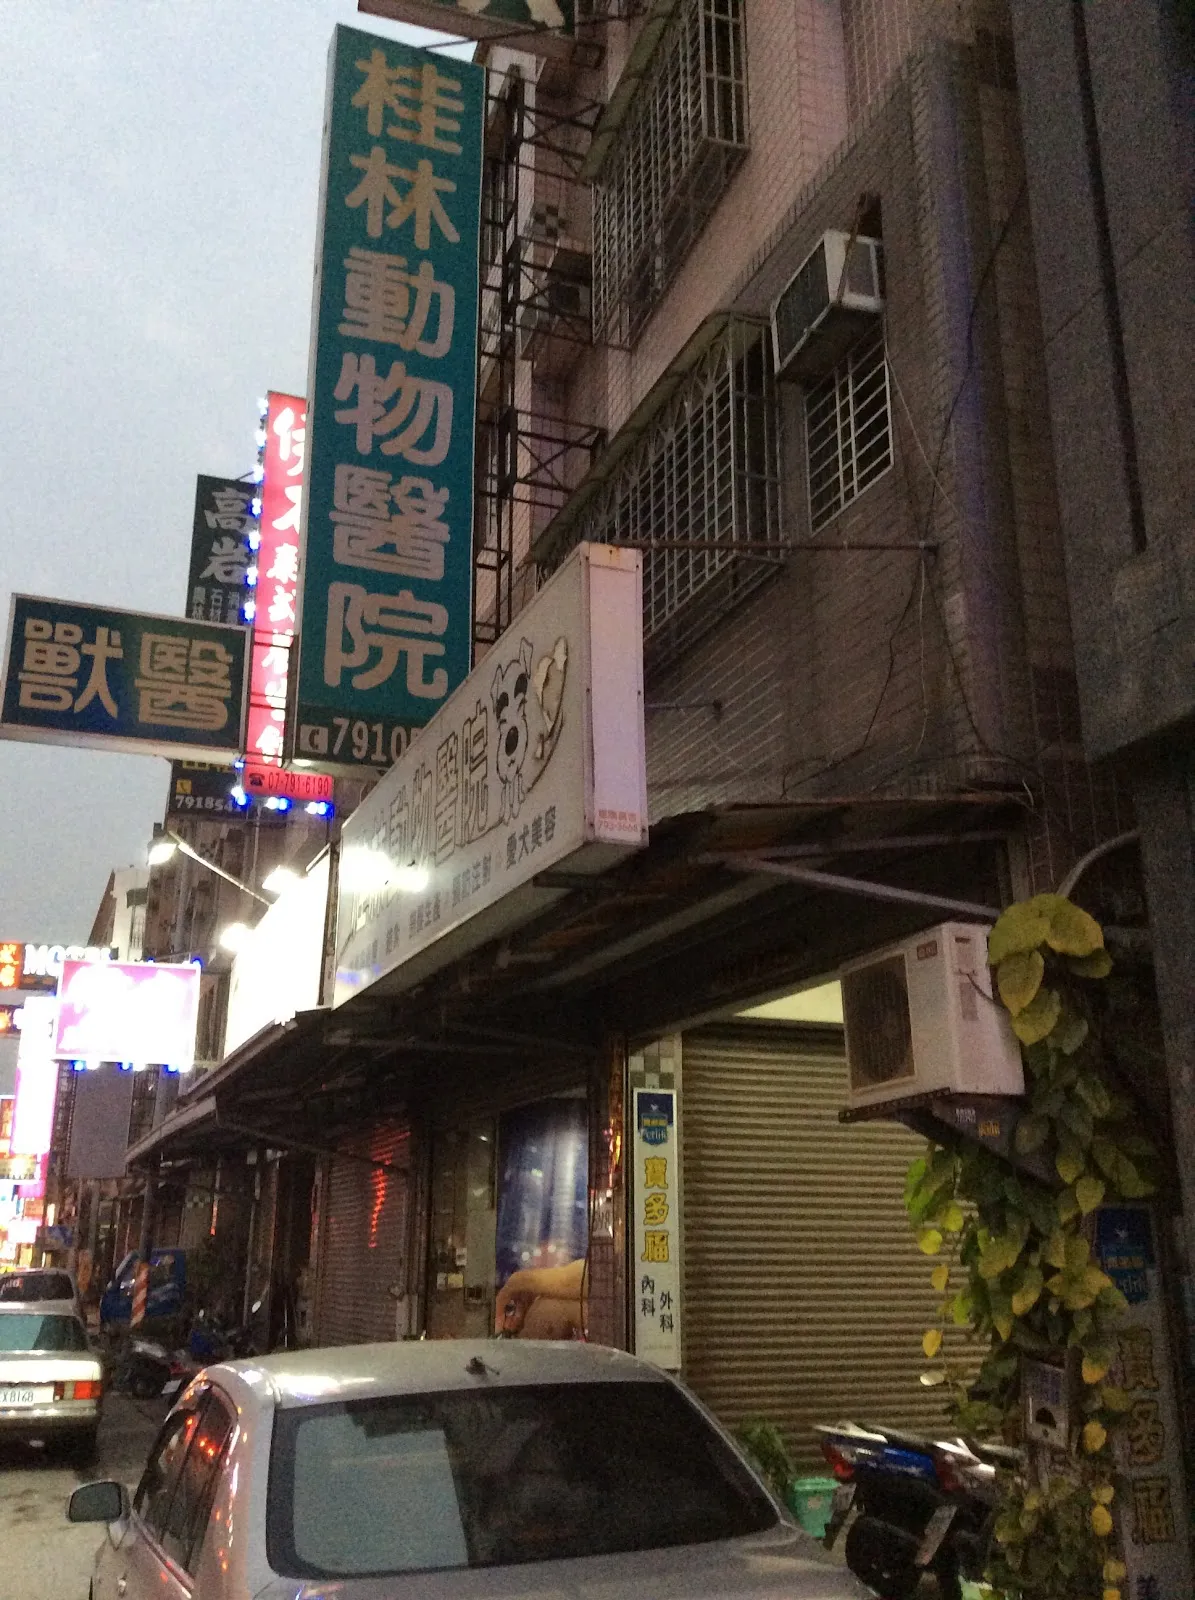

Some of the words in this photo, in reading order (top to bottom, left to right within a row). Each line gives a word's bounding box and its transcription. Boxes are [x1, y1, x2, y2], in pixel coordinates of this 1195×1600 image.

[324, 49, 464, 699] 桂林動物醫院
[18, 618, 233, 731] 獸醫
[334, 717, 420, 764] 7910
[268, 771, 329, 796] 07-791-6190
[506, 804, 556, 870] 愛犬美容
[641, 1156, 669, 1263] 寶多福
[660, 1290, 674, 1333] 外科
